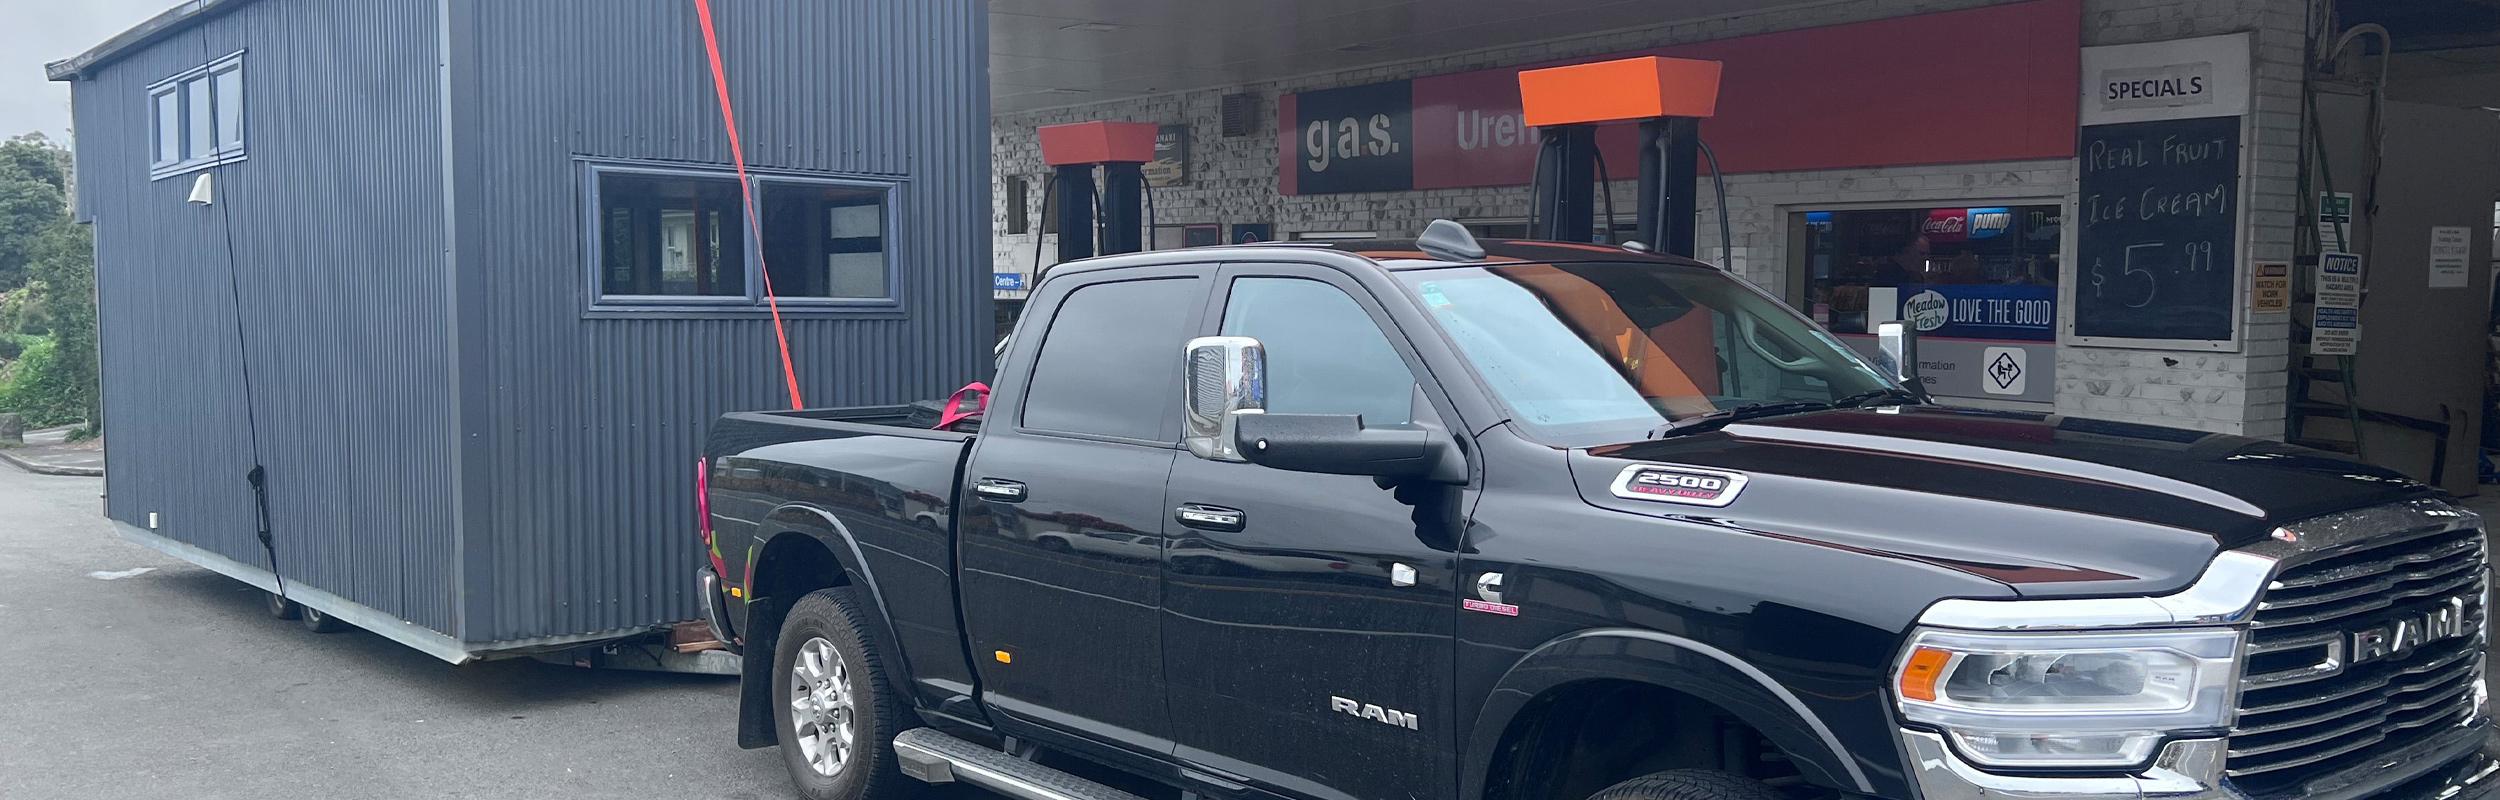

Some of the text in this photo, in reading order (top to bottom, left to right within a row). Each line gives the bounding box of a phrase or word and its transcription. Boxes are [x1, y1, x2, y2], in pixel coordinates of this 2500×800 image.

[2108, 77, 2202, 100] SPECIALS
[2090, 134, 2226, 172] REAL FRUIT
[2086, 184, 2226, 228] ICE CREAM
[1972, 213, 2012, 235] pump
[2326, 257, 2358, 272] NOTICE
[1907, 293, 1946, 318] Meadow
[1953, 298, 2050, 325] LOVE THE GOOD
[1638, 472, 1722, 490] 2500
[2353, 607, 2458, 663] RAM
[1331, 695, 1419, 731] RAM
